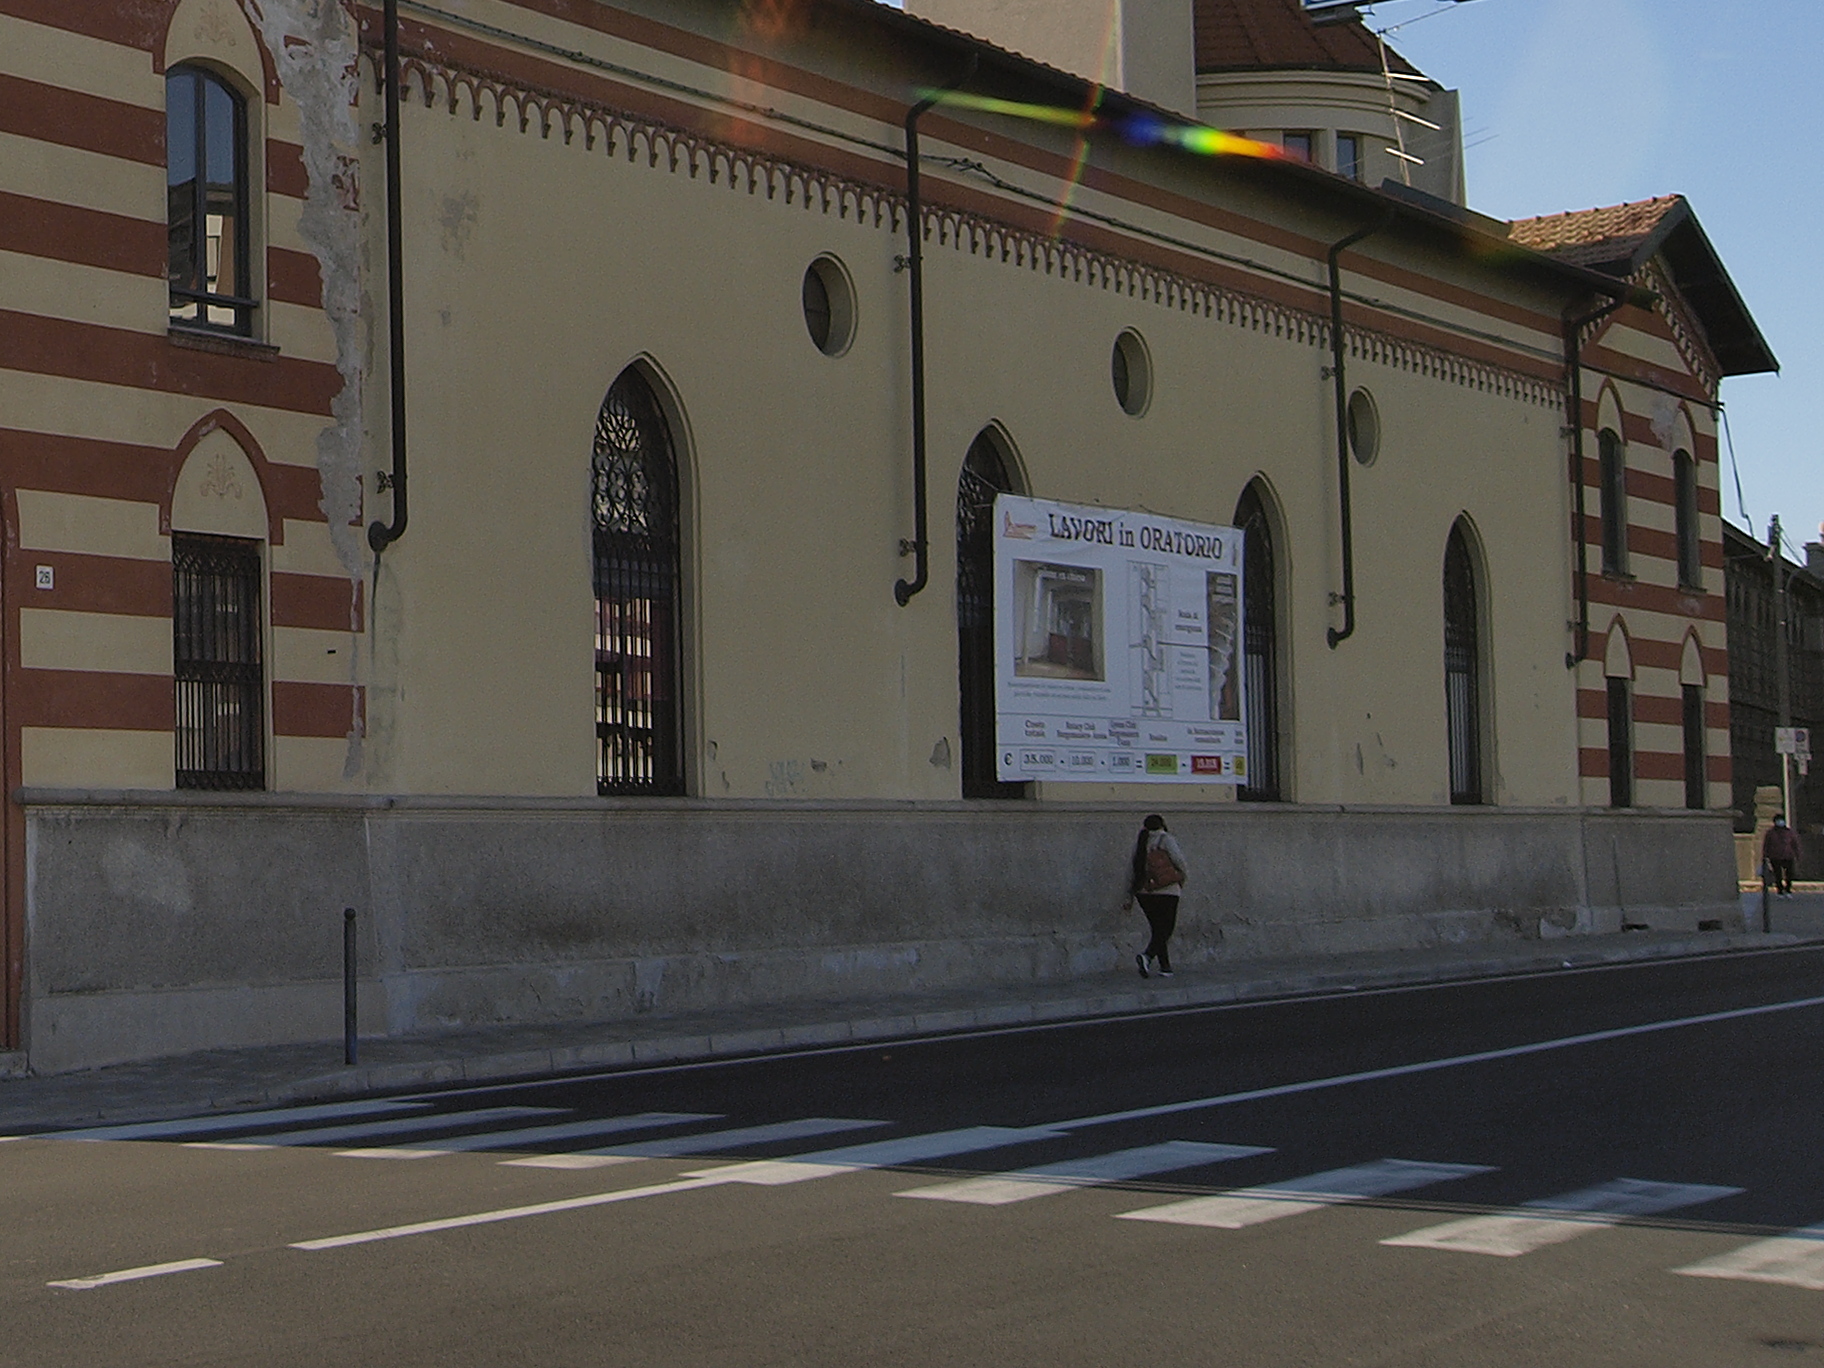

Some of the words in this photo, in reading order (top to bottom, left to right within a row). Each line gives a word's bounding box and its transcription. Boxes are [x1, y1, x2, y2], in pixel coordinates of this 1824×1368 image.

[1048, 513, 1113, 546] LAVORI
[1119, 522, 1135, 548] in
[1140, 526, 1223, 560] ORATORIO
[39, 570, 50, 583] 26
